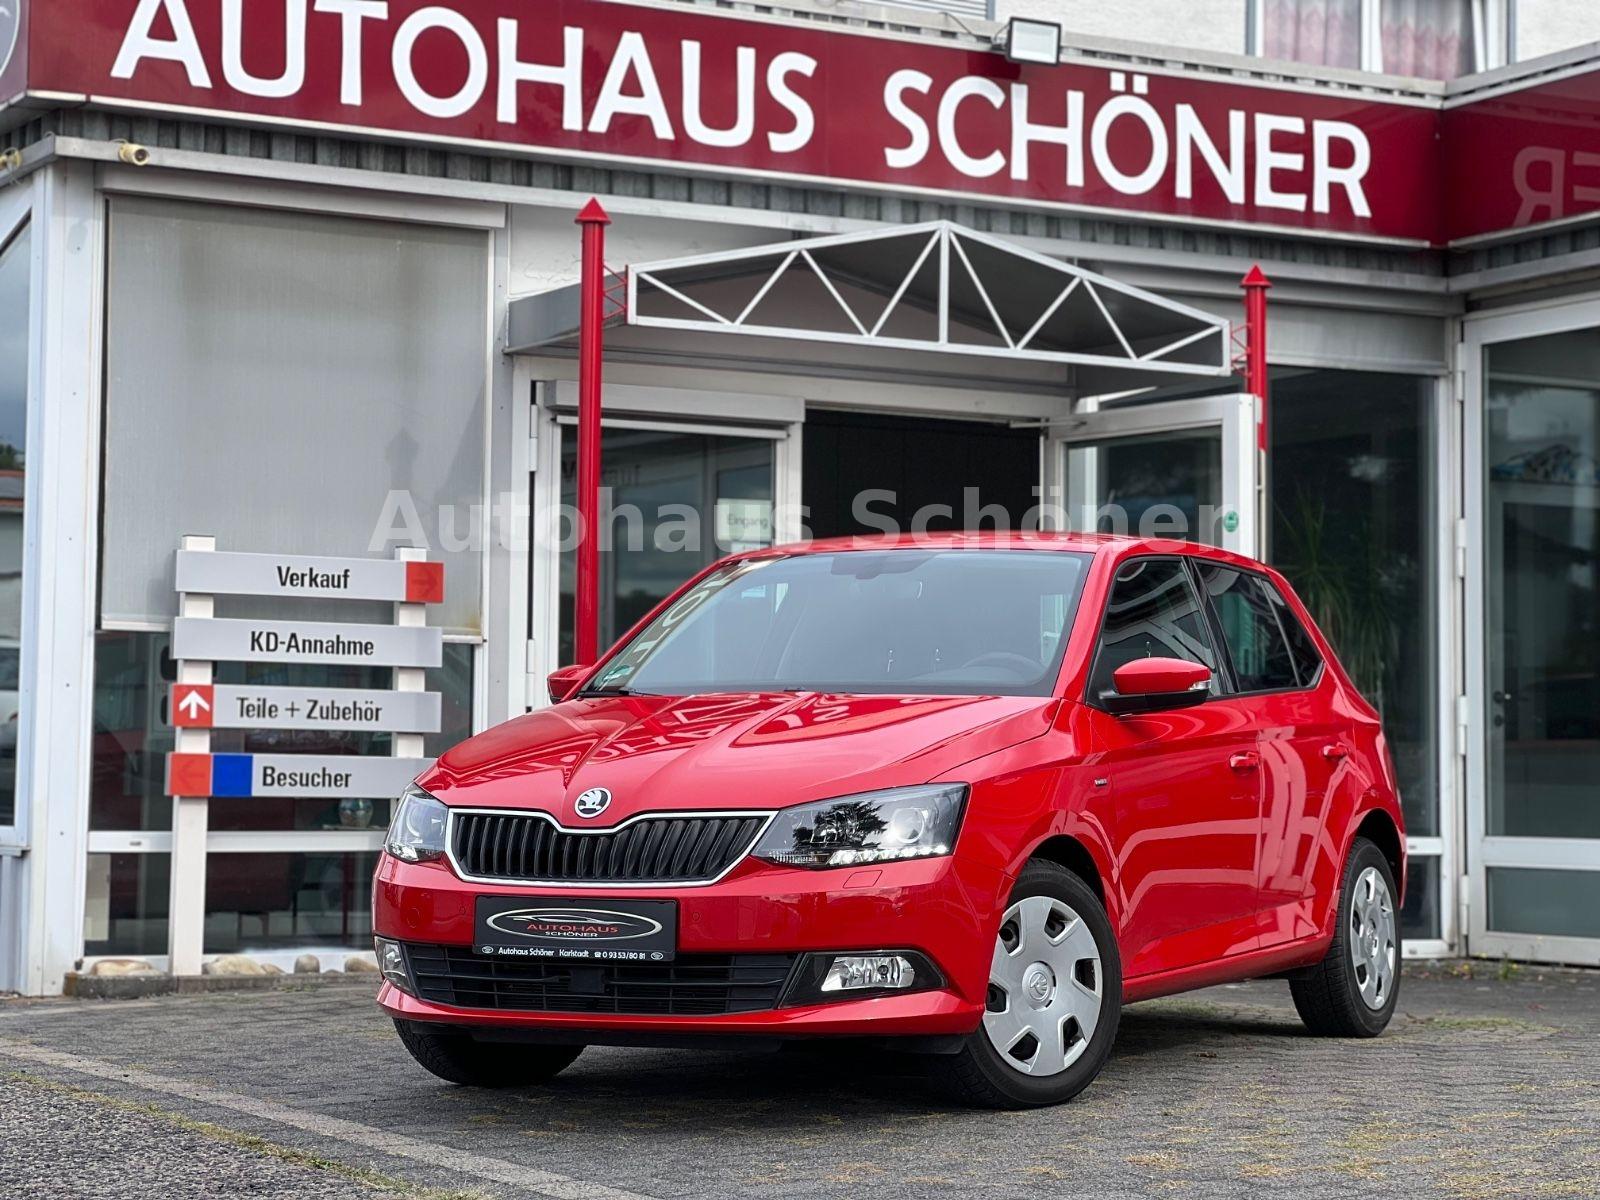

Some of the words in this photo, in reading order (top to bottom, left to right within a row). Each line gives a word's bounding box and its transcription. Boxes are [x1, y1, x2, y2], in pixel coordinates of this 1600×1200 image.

[110, 0, 818, 153] AUTOHAUS
[884, 69, 1372, 218] SCHÖNER
[277, 566, 350, 589] Verkauf
[250, 630, 374, 656] KD-Annahme
[236, 697, 278, 719] Teile
[284, 701, 300, 718] +
[306, 699, 382, 722] Zubehör
[262, 766, 352, 788] Besucher
[527, 923, 619, 933] AUTOHAUS
[498, 946, 528, 955] Autohaus
[529, 947, 554, 956] Schöner
[559, 948, 589, 958] Karlstadt
